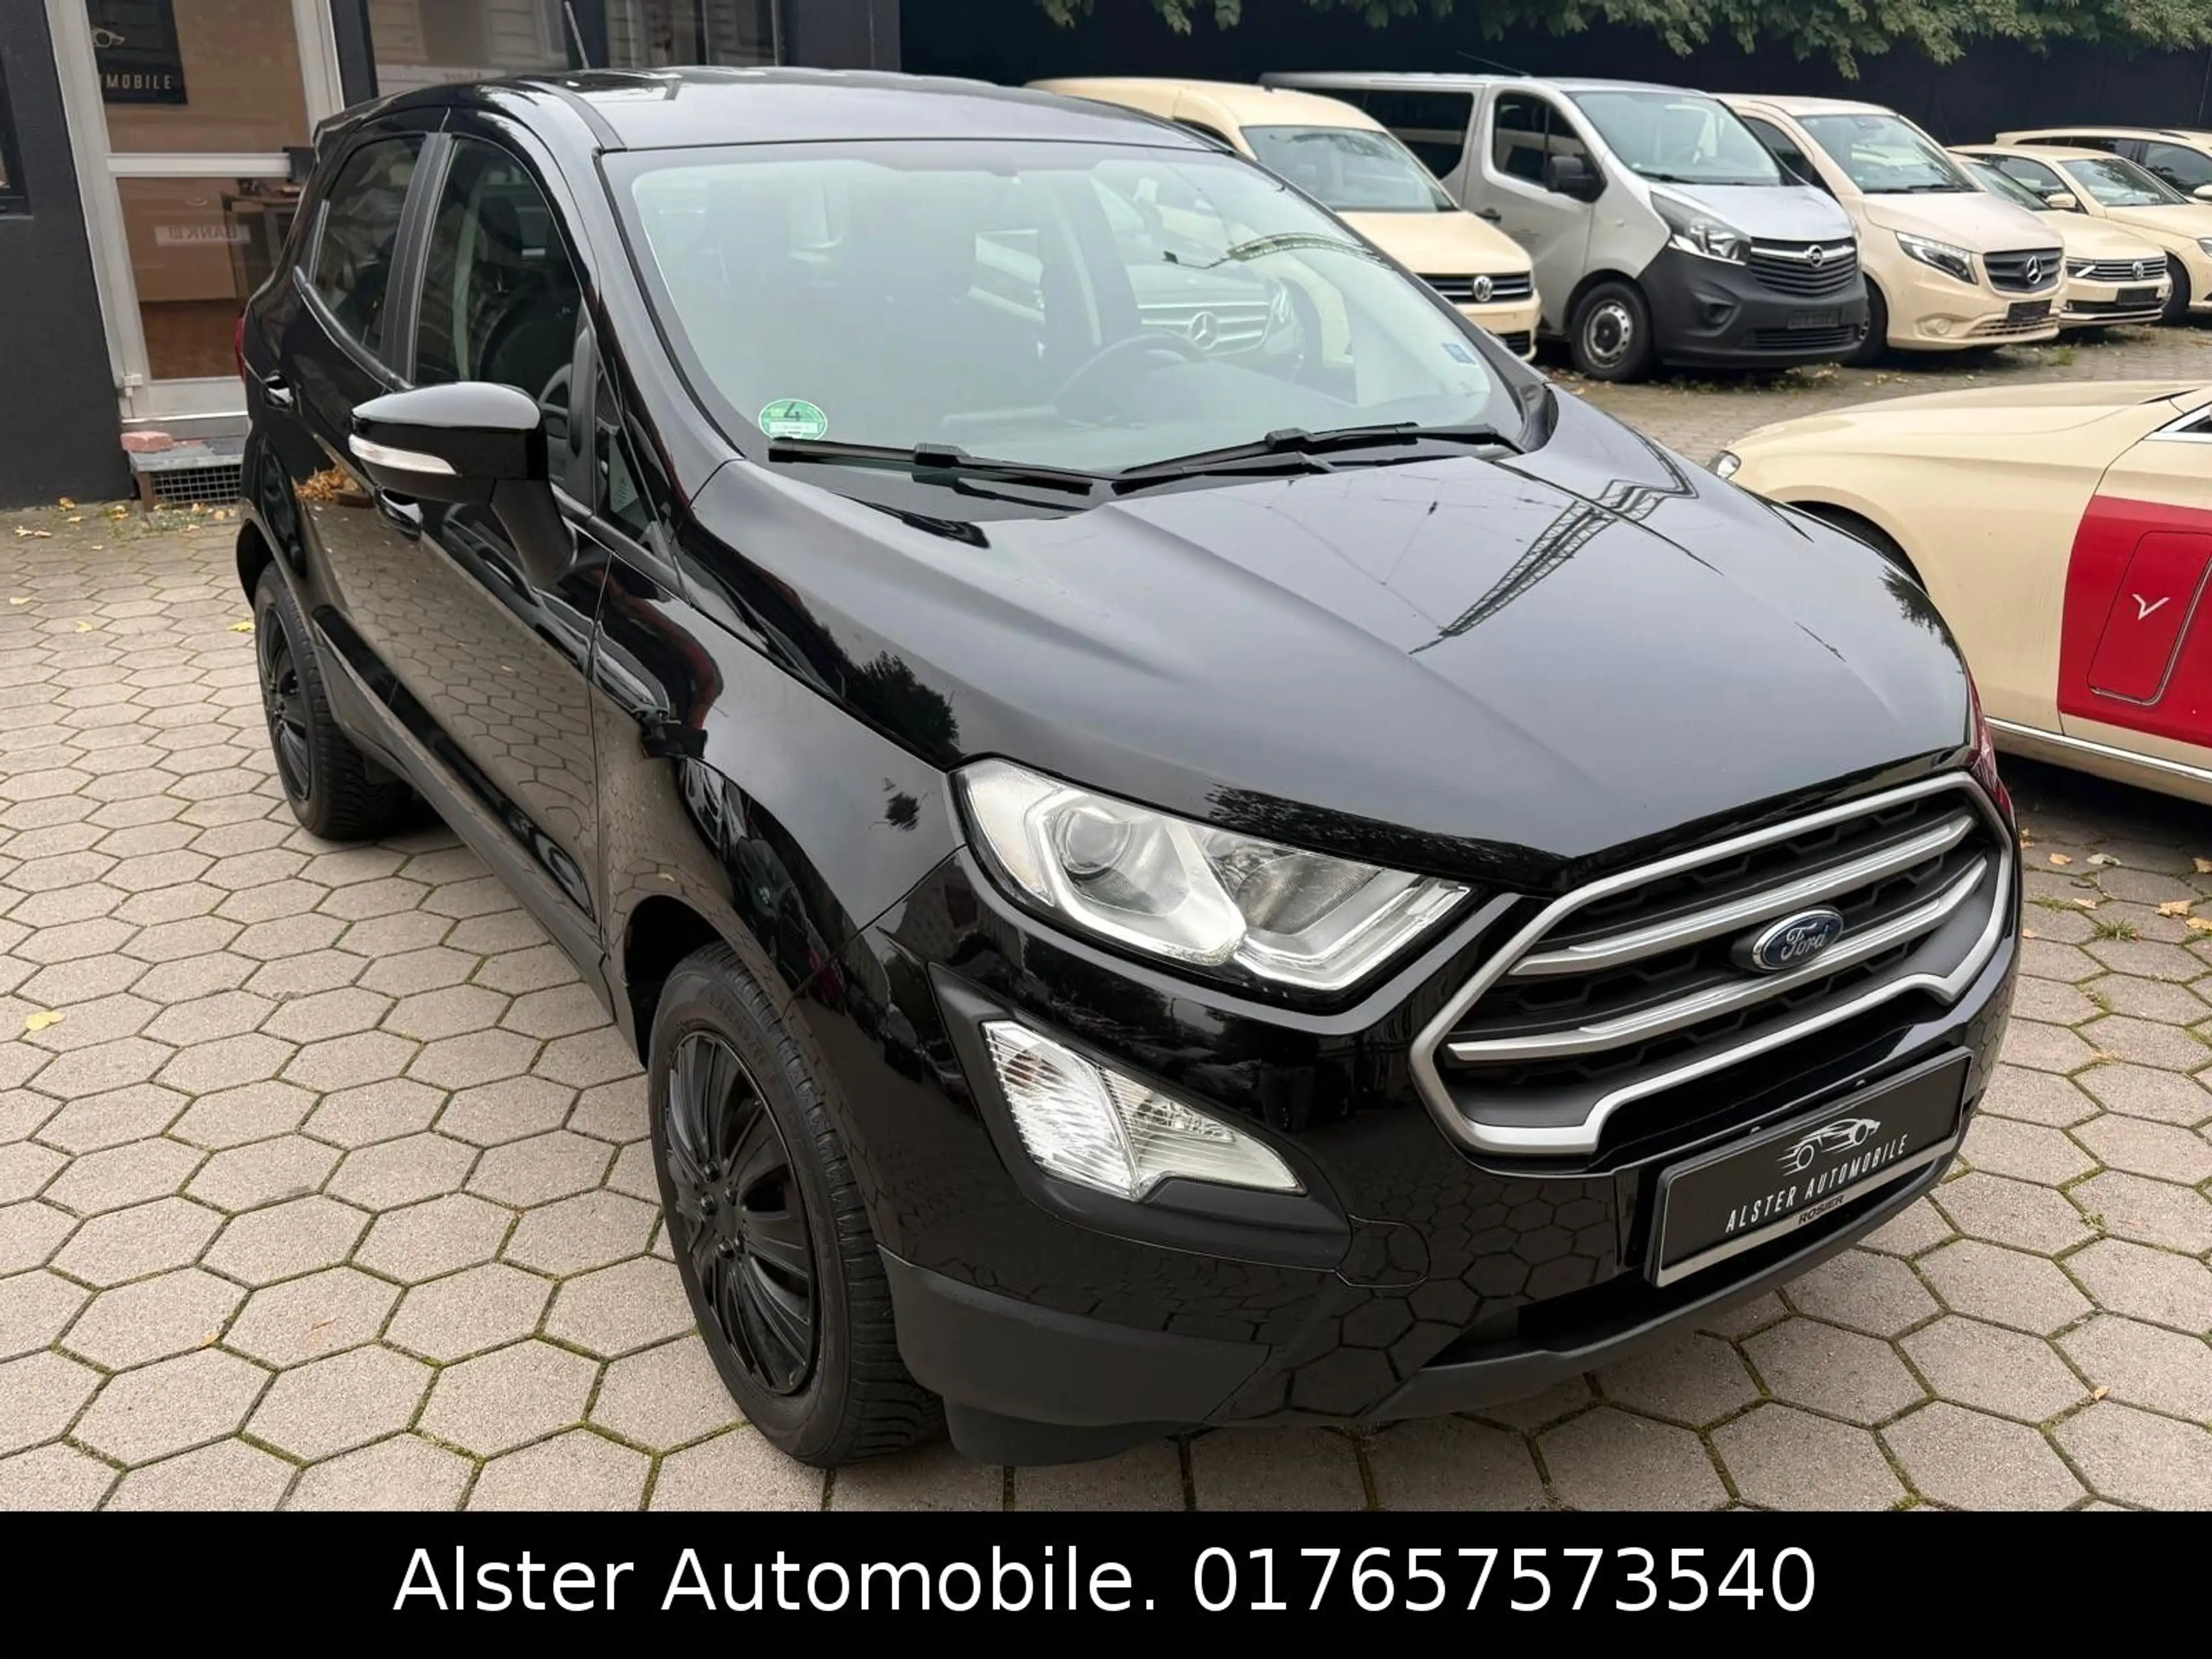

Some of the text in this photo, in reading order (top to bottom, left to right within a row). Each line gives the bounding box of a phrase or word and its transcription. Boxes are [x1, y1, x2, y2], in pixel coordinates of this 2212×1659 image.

[784, 402, 803, 421] 4
[1780, 922, 1830, 960] Ford
[1725, 1133, 1908, 1233] ALSTER AUTOMOBILE
